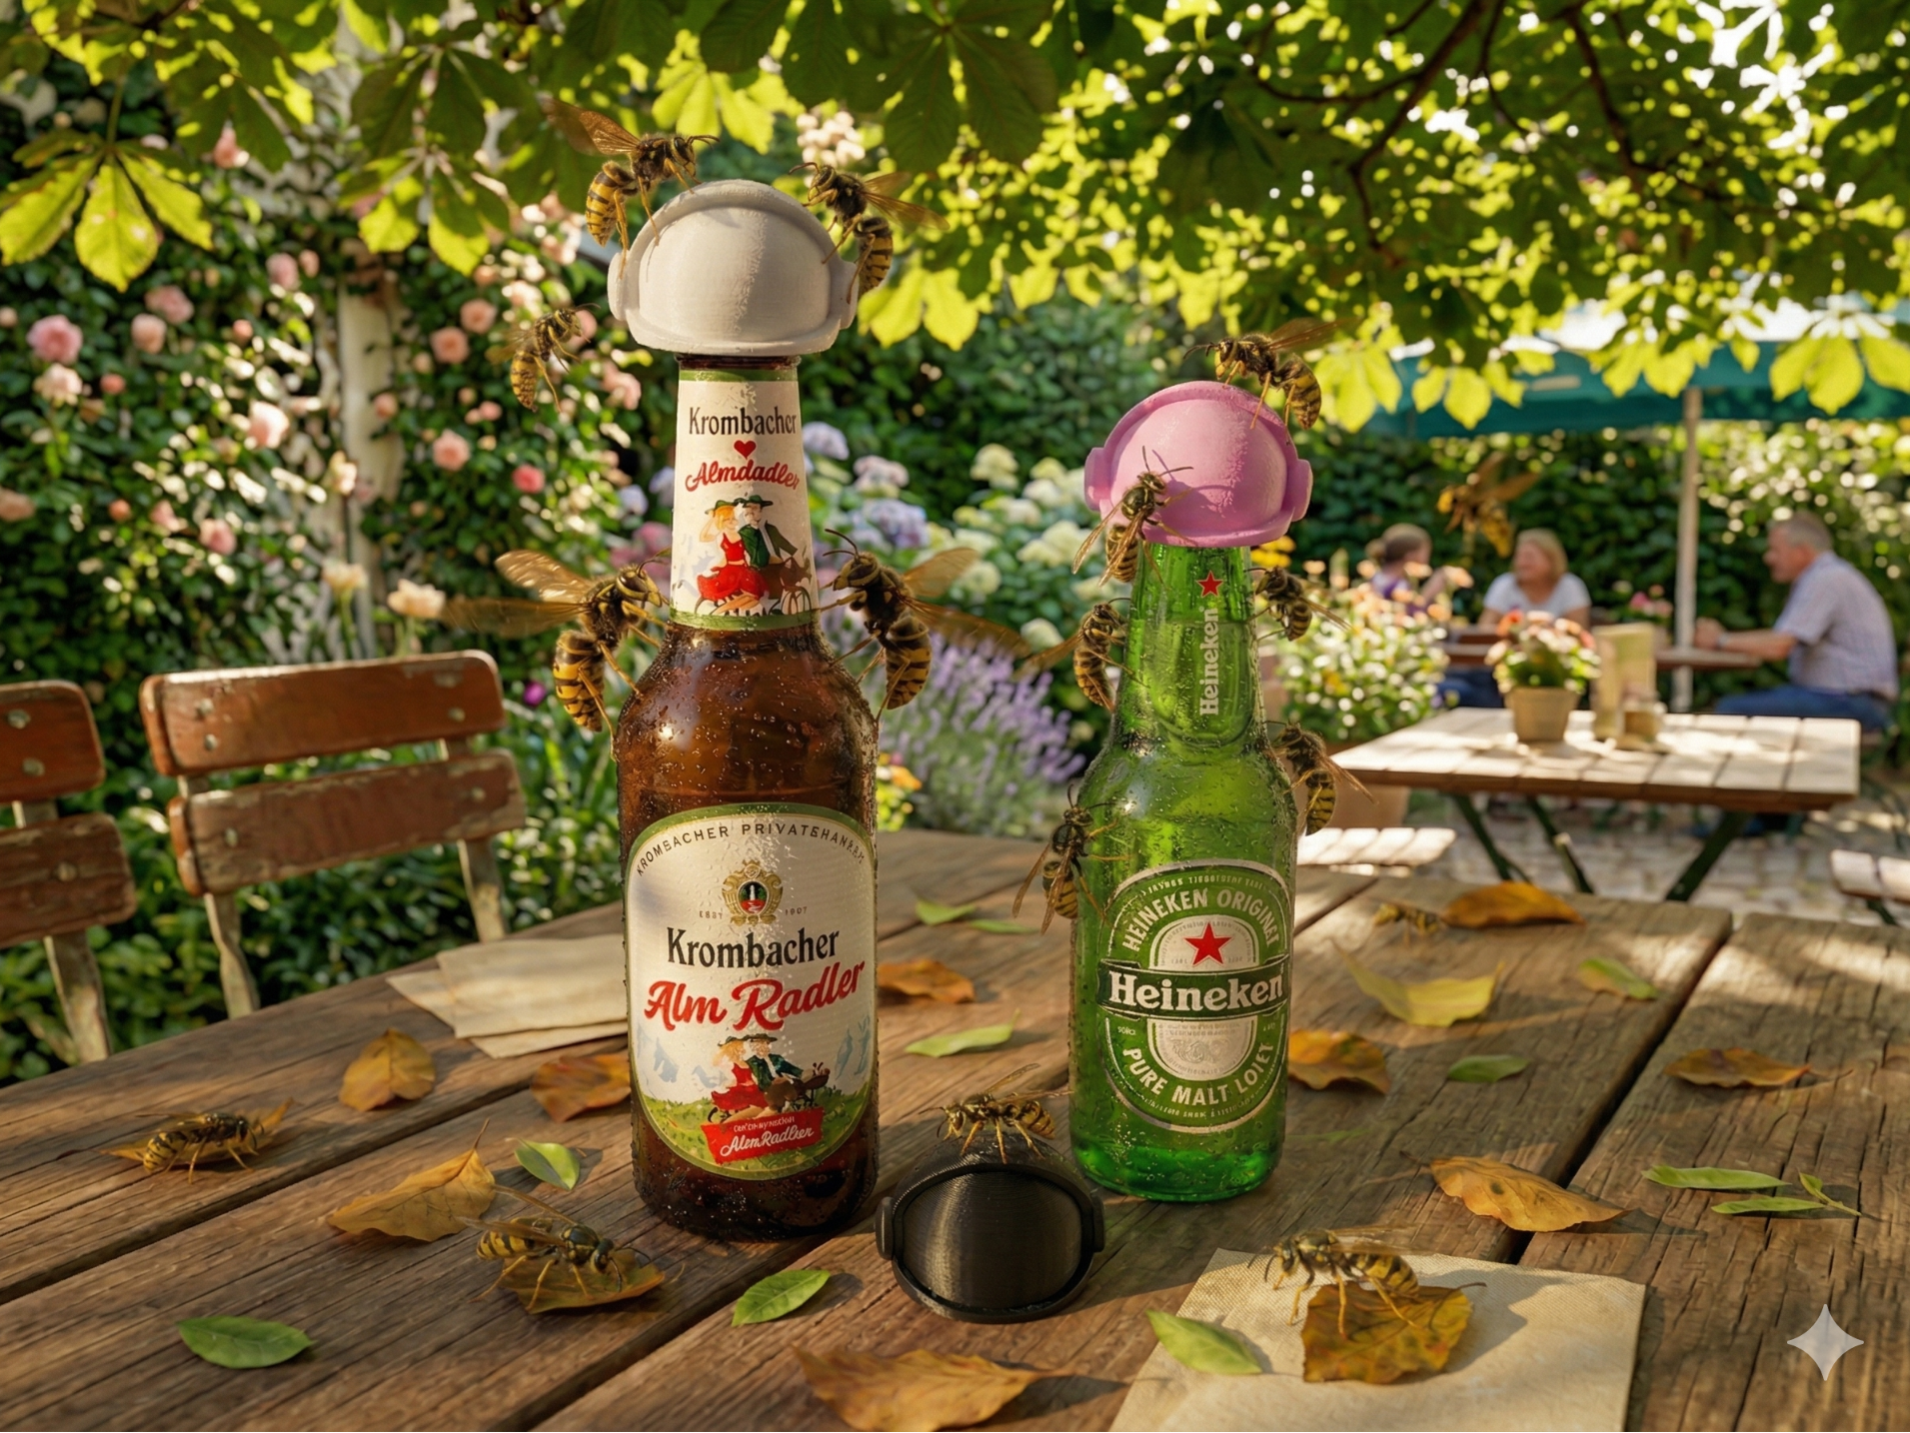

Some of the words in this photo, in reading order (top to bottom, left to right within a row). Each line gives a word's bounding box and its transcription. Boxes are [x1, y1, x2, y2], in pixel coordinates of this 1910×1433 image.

[689, 406, 797, 435] Krombacher
[1200, 607, 1219, 716] Heineken
[636, 826, 730, 877] KROMBACHER
[1122, 888, 1209, 952] HEINEKEN
[667, 927, 840, 968] Krombacher
[644, 980, 728, 1031] Alm
[731, 961, 866, 1031] Radler
[1109, 971, 1283, 1011] Heineken
[1123, 1048, 1168, 1095] PURE
[1172, 1085, 1228, 1106] MALT
